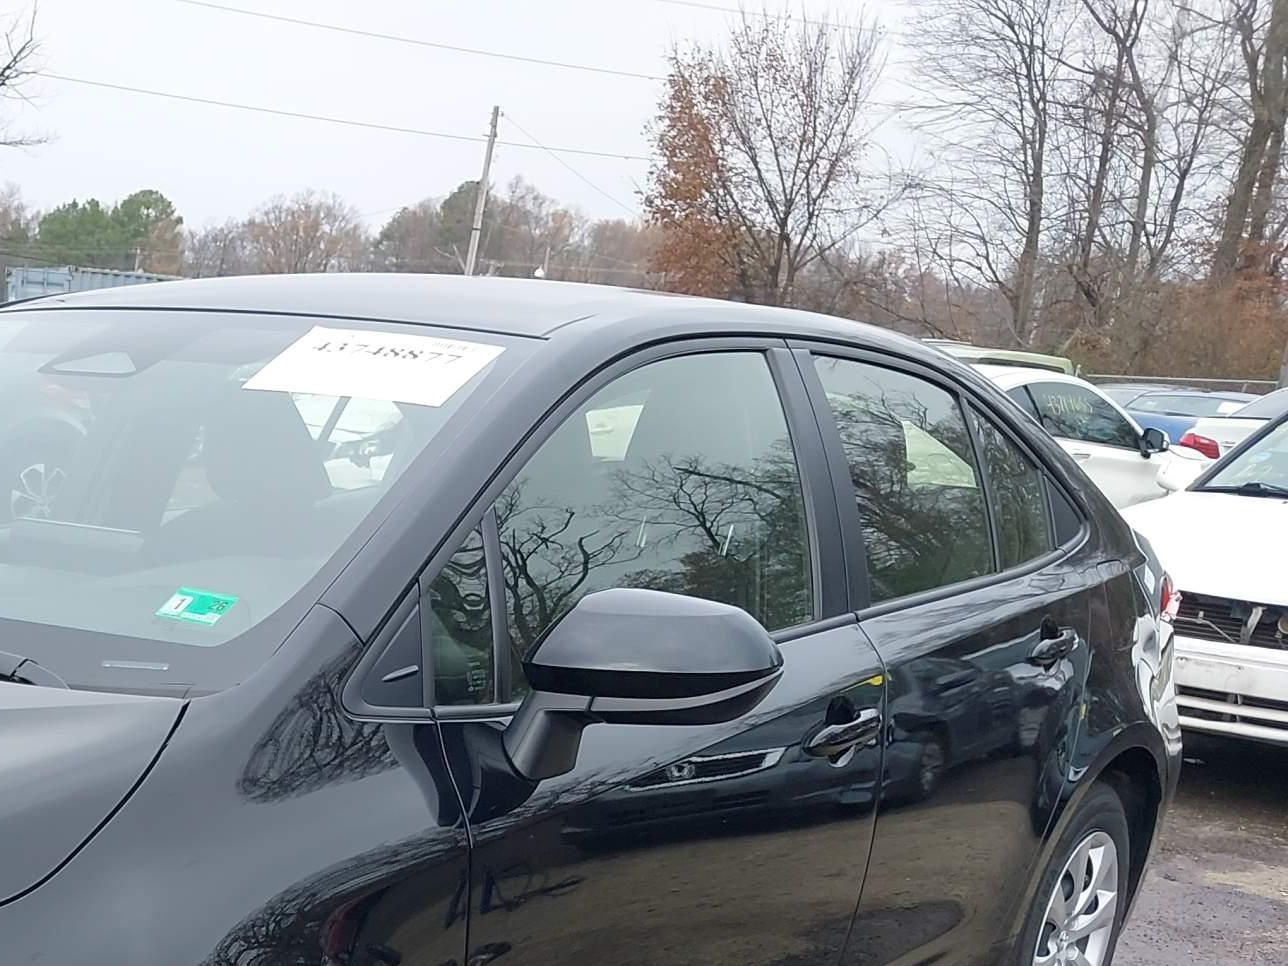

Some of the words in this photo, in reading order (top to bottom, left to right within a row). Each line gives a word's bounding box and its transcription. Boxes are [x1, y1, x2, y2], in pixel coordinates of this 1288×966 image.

[312, 340, 464, 365] 43748877
[173, 597, 187, 611] 1
[209, 600, 229, 612] 26
